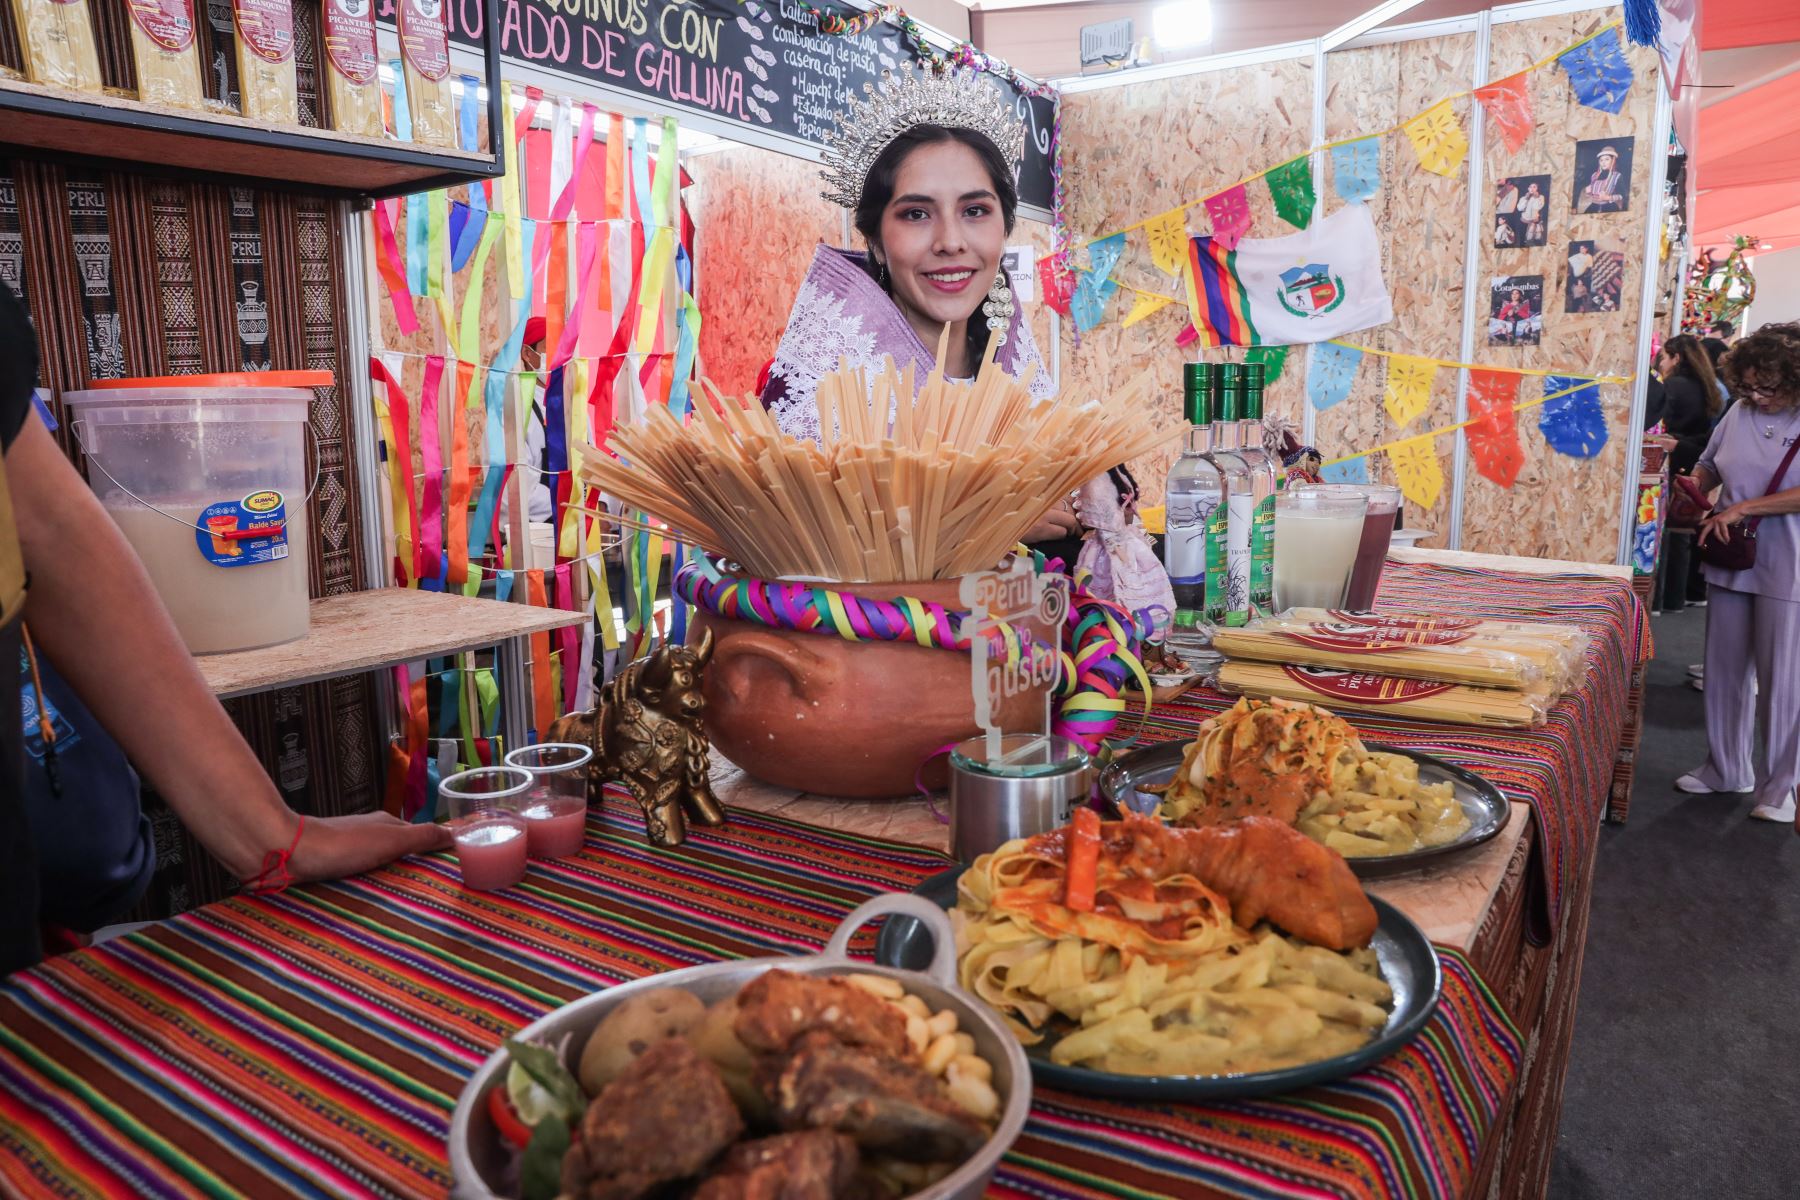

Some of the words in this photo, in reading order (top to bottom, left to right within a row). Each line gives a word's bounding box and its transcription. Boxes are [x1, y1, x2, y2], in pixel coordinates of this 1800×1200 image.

[659, 4, 724, 63] CON
[582, 25, 626, 77] DE
[635, 42, 750, 121] GALLINA
[783, 49, 823, 74] casera
[836, 41, 849, 62] de
[850, 50, 876, 76] pasta
[68, 191, 106, 207] PERU
[232, 241, 262, 256] PERU
[988, 642, 1055, 719] gusto
